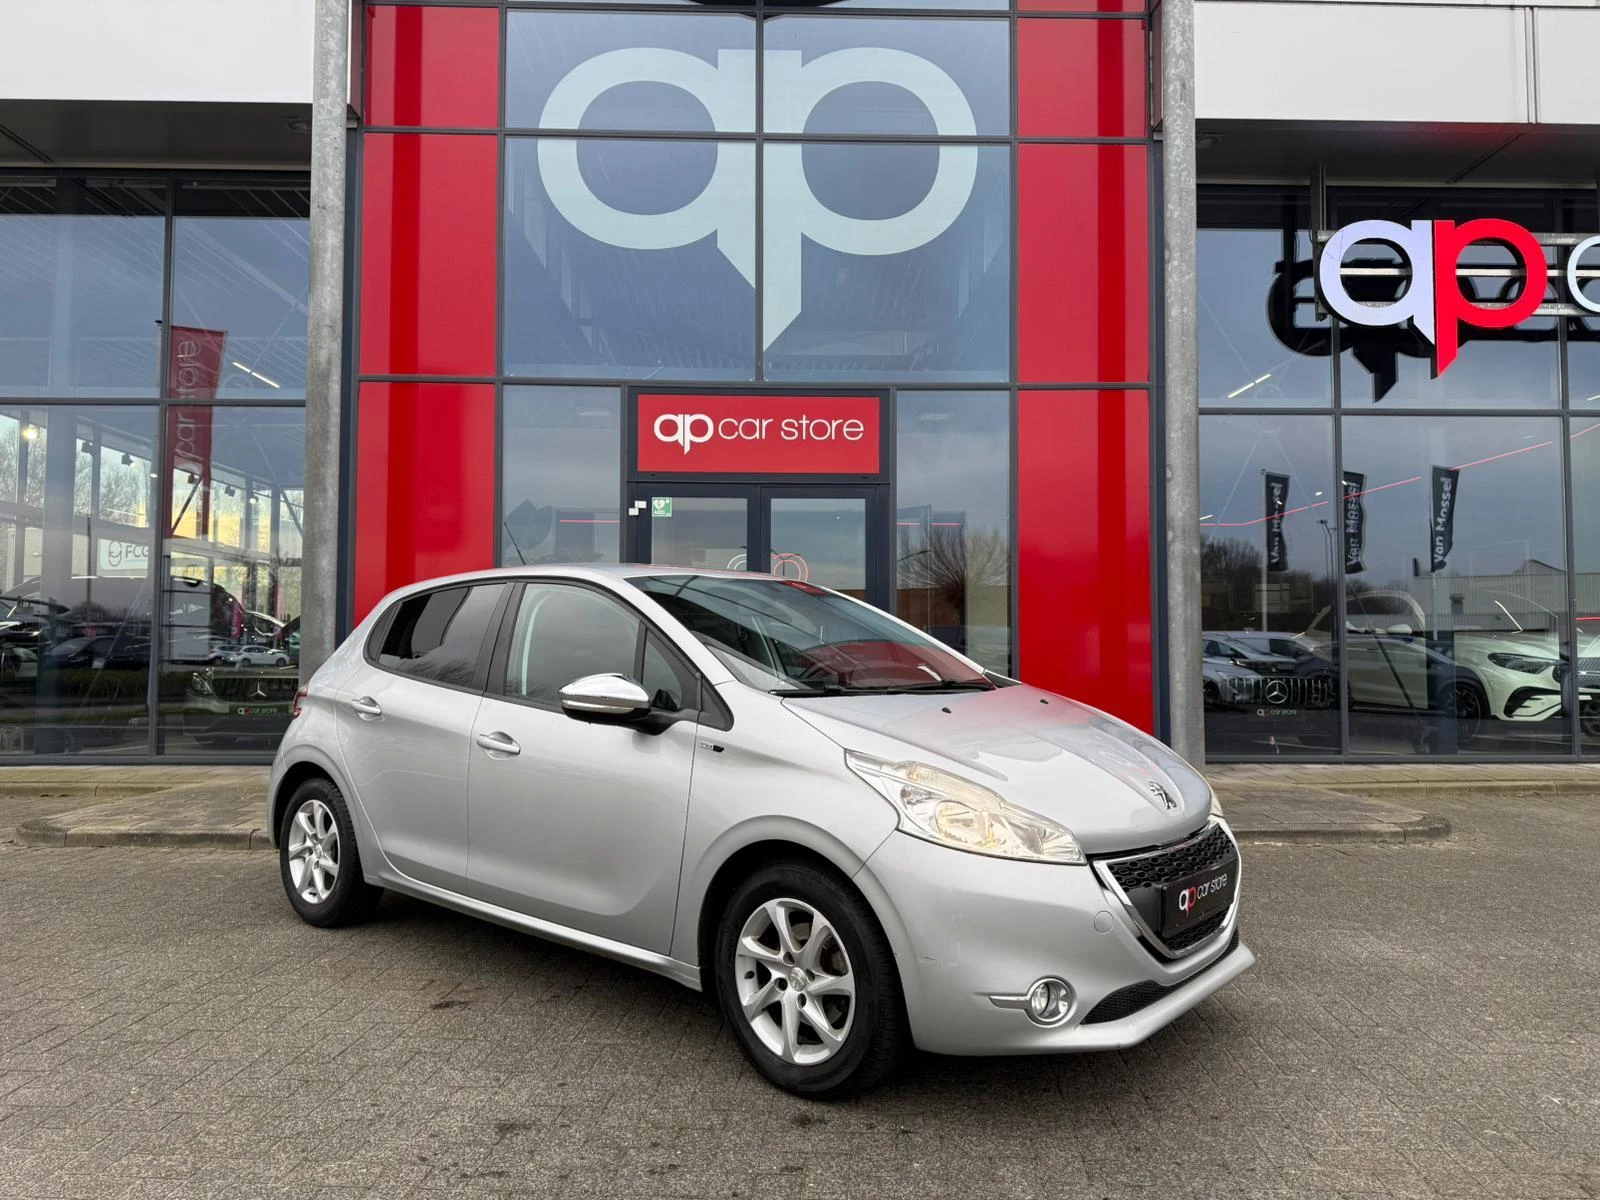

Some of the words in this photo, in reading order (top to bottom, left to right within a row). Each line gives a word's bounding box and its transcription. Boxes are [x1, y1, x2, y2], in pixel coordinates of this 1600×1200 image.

[537, 47, 978, 353] ap
[1319, 218, 1548, 378] ap
[653, 413, 714, 456] ap
[718, 418, 773, 440] car
[780, 414, 865, 441] store
[1435, 477, 1452, 531] Mossel
[1434, 536, 1444, 562] Van
[1179, 886, 1197, 918] ap
[1197, 882, 1211, 899] car
[1210, 873, 1228, 893] store
